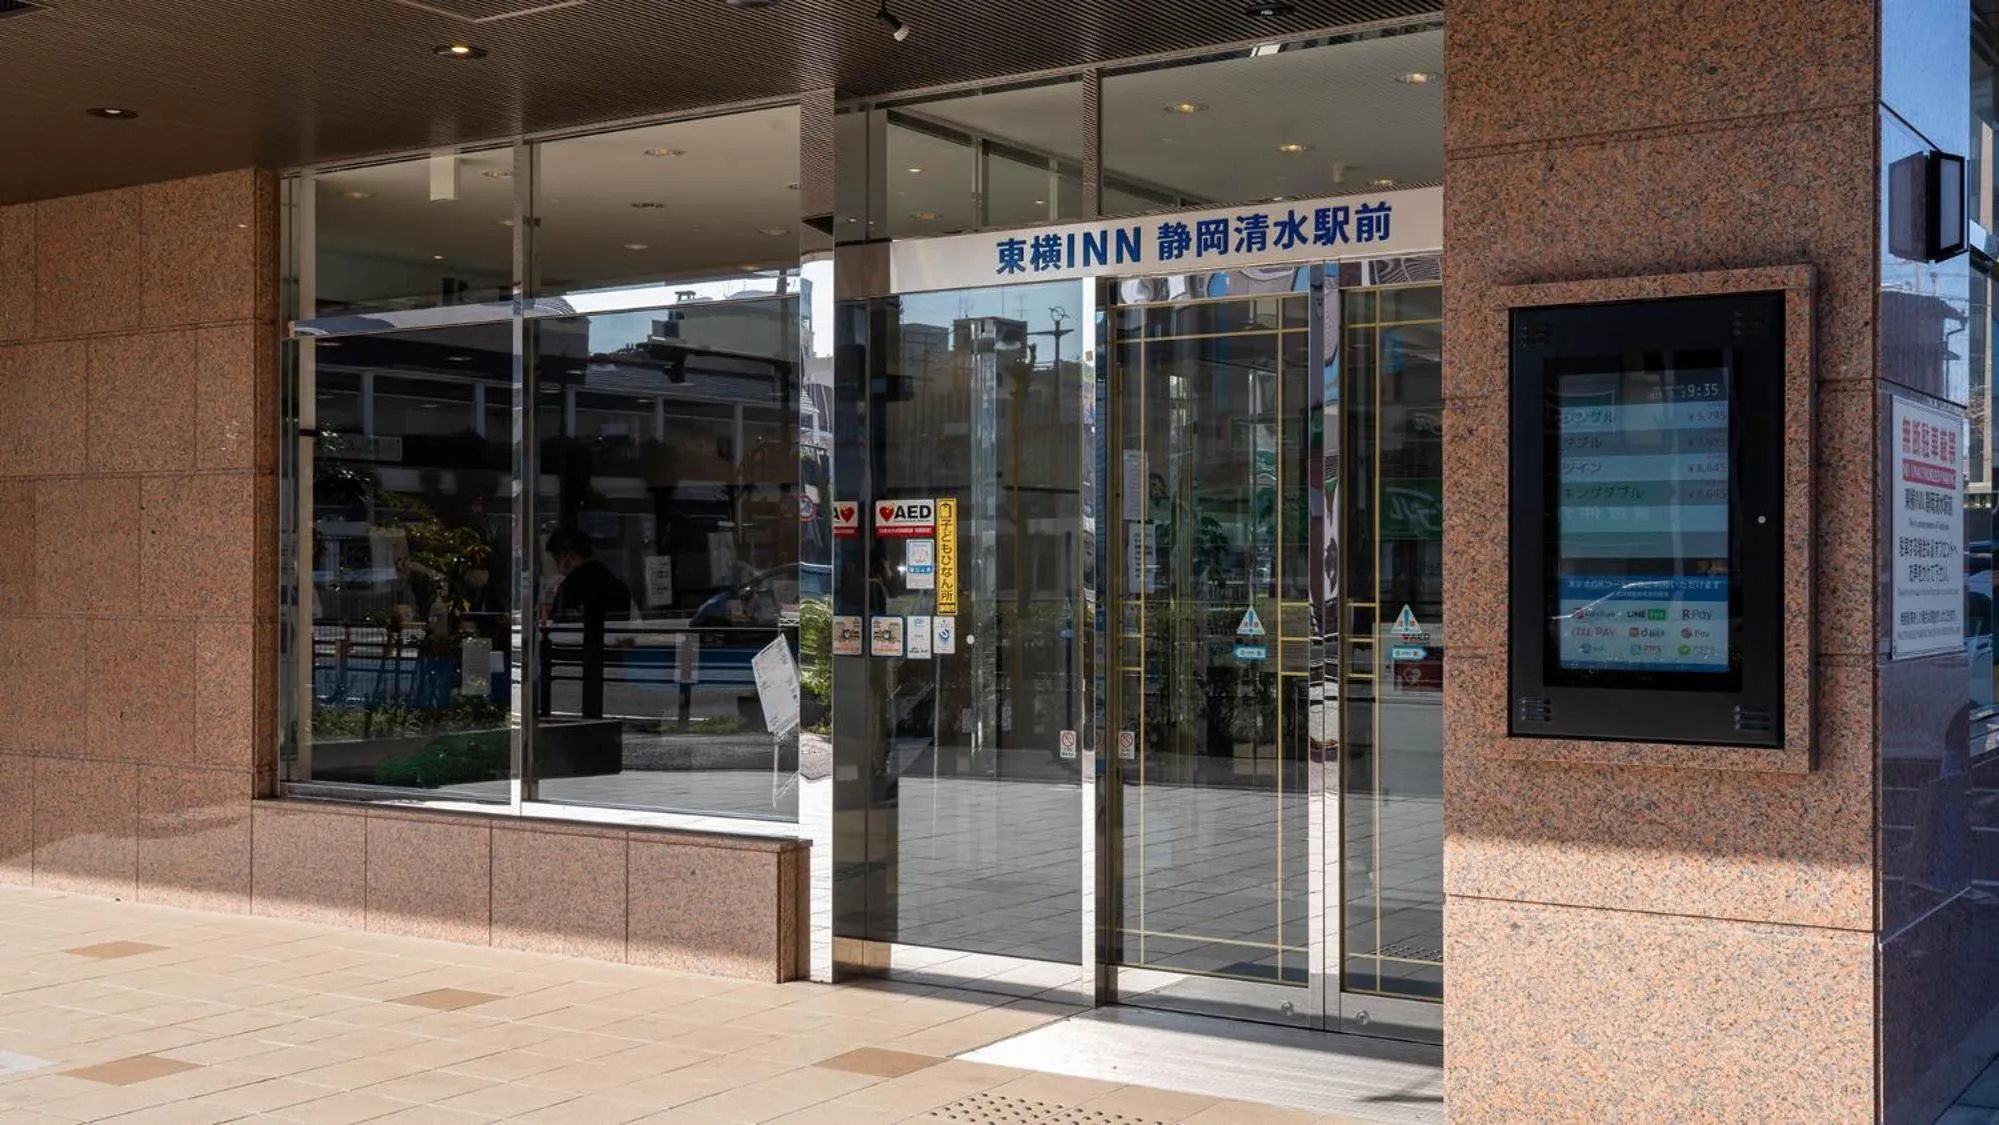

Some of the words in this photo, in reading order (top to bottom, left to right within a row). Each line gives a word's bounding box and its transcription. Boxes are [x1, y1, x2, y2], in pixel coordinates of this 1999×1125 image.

[996, 226, 1142, 275] 東横INN
[1156, 200, 1392, 262] 静岡清水駅前
[894, 505, 931, 519] AED
